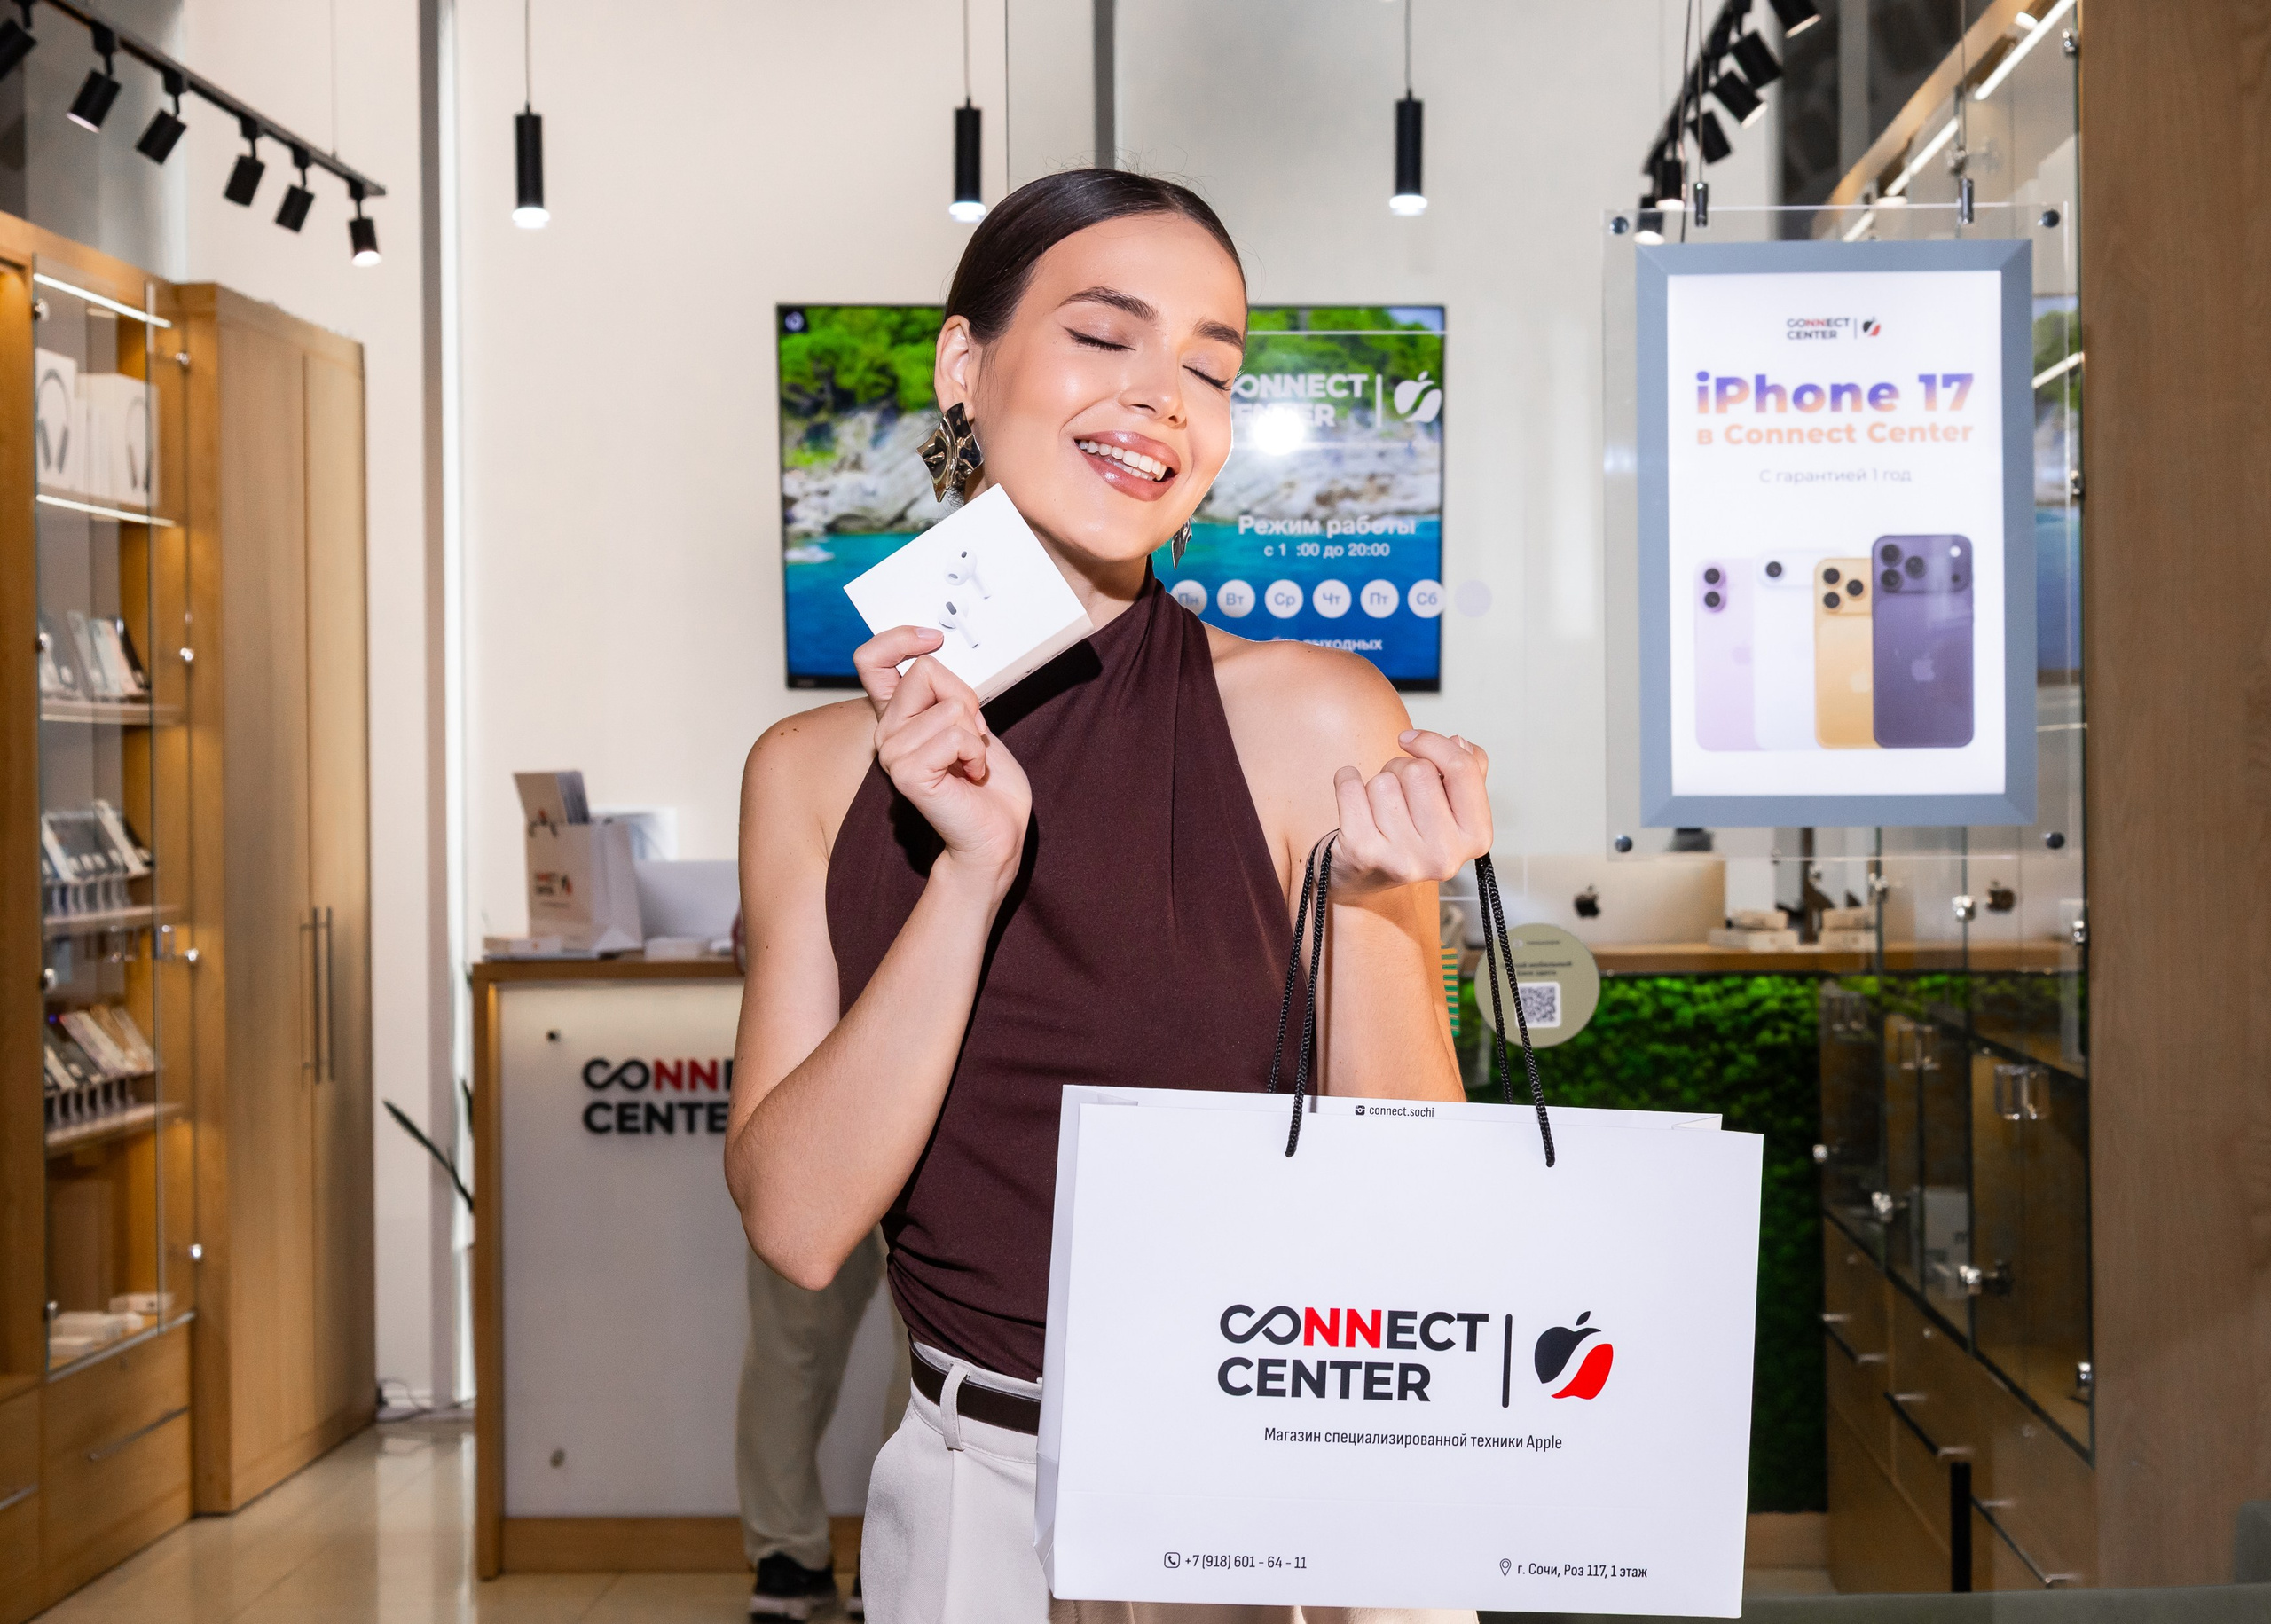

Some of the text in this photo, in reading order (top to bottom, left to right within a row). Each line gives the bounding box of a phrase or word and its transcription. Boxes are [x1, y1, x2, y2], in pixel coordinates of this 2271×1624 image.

[1787, 318, 1850, 328] CONNECT
[1787, 330, 1837, 340] CENTER
[1230, 373, 1369, 398] ONNECT
[1696, 371, 1974, 414] iPhone 17
[1697, 422, 1973, 444] в Connect Center
[1759, 469, 1772, 483] С
[1776, 468, 1867, 485] гарантией
[1882, 470, 1912, 482] год
[1238, 515, 1416, 538] Режим работы
[1264, 545, 1273, 556] с
[1323, 545, 1344, 559] до
[1348, 543, 1390, 557] 20:00
[1226, 592, 1244, 606] Вт
[1274, 592, 1295, 607] Ср
[1323, 592, 1341, 606] Чт
[1370, 592, 1388, 606] Пт
[1417, 592, 1438, 606] Сб
[584, 1101, 729, 1134] CENTE
[1369, 1106, 1434, 1118] connect.sochi
[1220, 1304, 1489, 1352] CONNECT
[1217, 1356, 1431, 1402] CENTER
[1264, 1427, 1562, 1450] Магазин специализированной техники Apple
[1185, 1555, 1199, 1567] +7
[1202, 1554, 1231, 1570] (918)
[1234, 1556, 1255, 1568] 601
[1267, 1556, 1283, 1569] 64
[1294, 1557, 1307, 1569] 11
[1517, 1563, 1647, 1580] г. Сочи, Роз 117, 1 этаж
